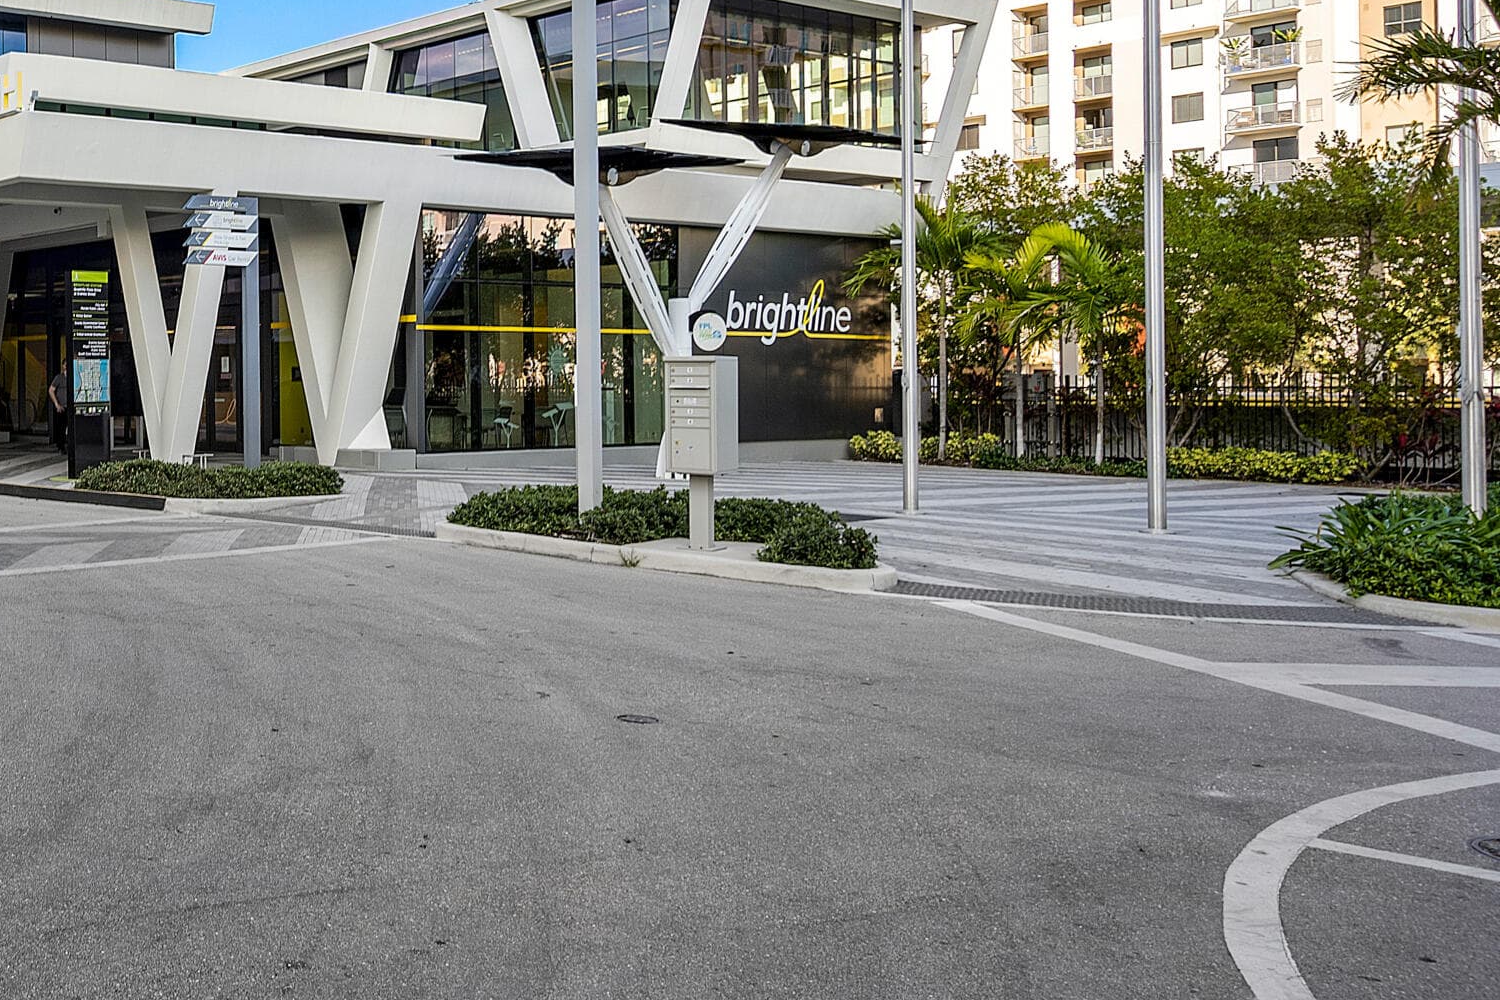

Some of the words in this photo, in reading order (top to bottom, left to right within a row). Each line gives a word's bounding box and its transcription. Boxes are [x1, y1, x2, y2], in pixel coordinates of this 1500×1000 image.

[209, 198, 239, 210] brightline
[212, 254, 227, 262] AVIS
[726, 279, 852, 346] brightline
